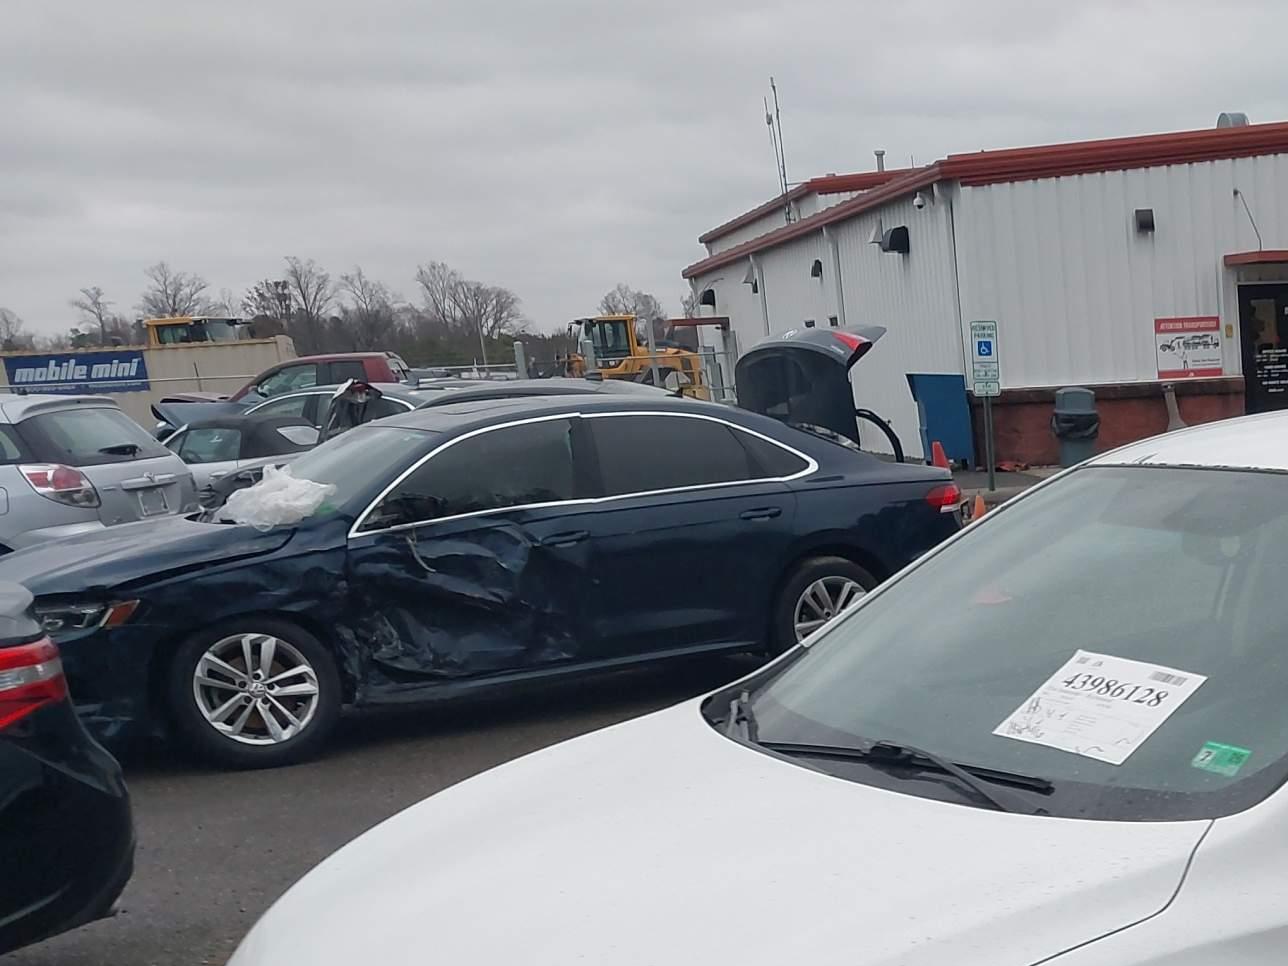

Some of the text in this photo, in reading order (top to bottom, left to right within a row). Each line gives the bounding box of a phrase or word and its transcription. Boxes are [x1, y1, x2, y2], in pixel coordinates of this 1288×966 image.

[14, 358, 141, 383] mobile mini
[1063, 673, 1169, 708] 43986128
